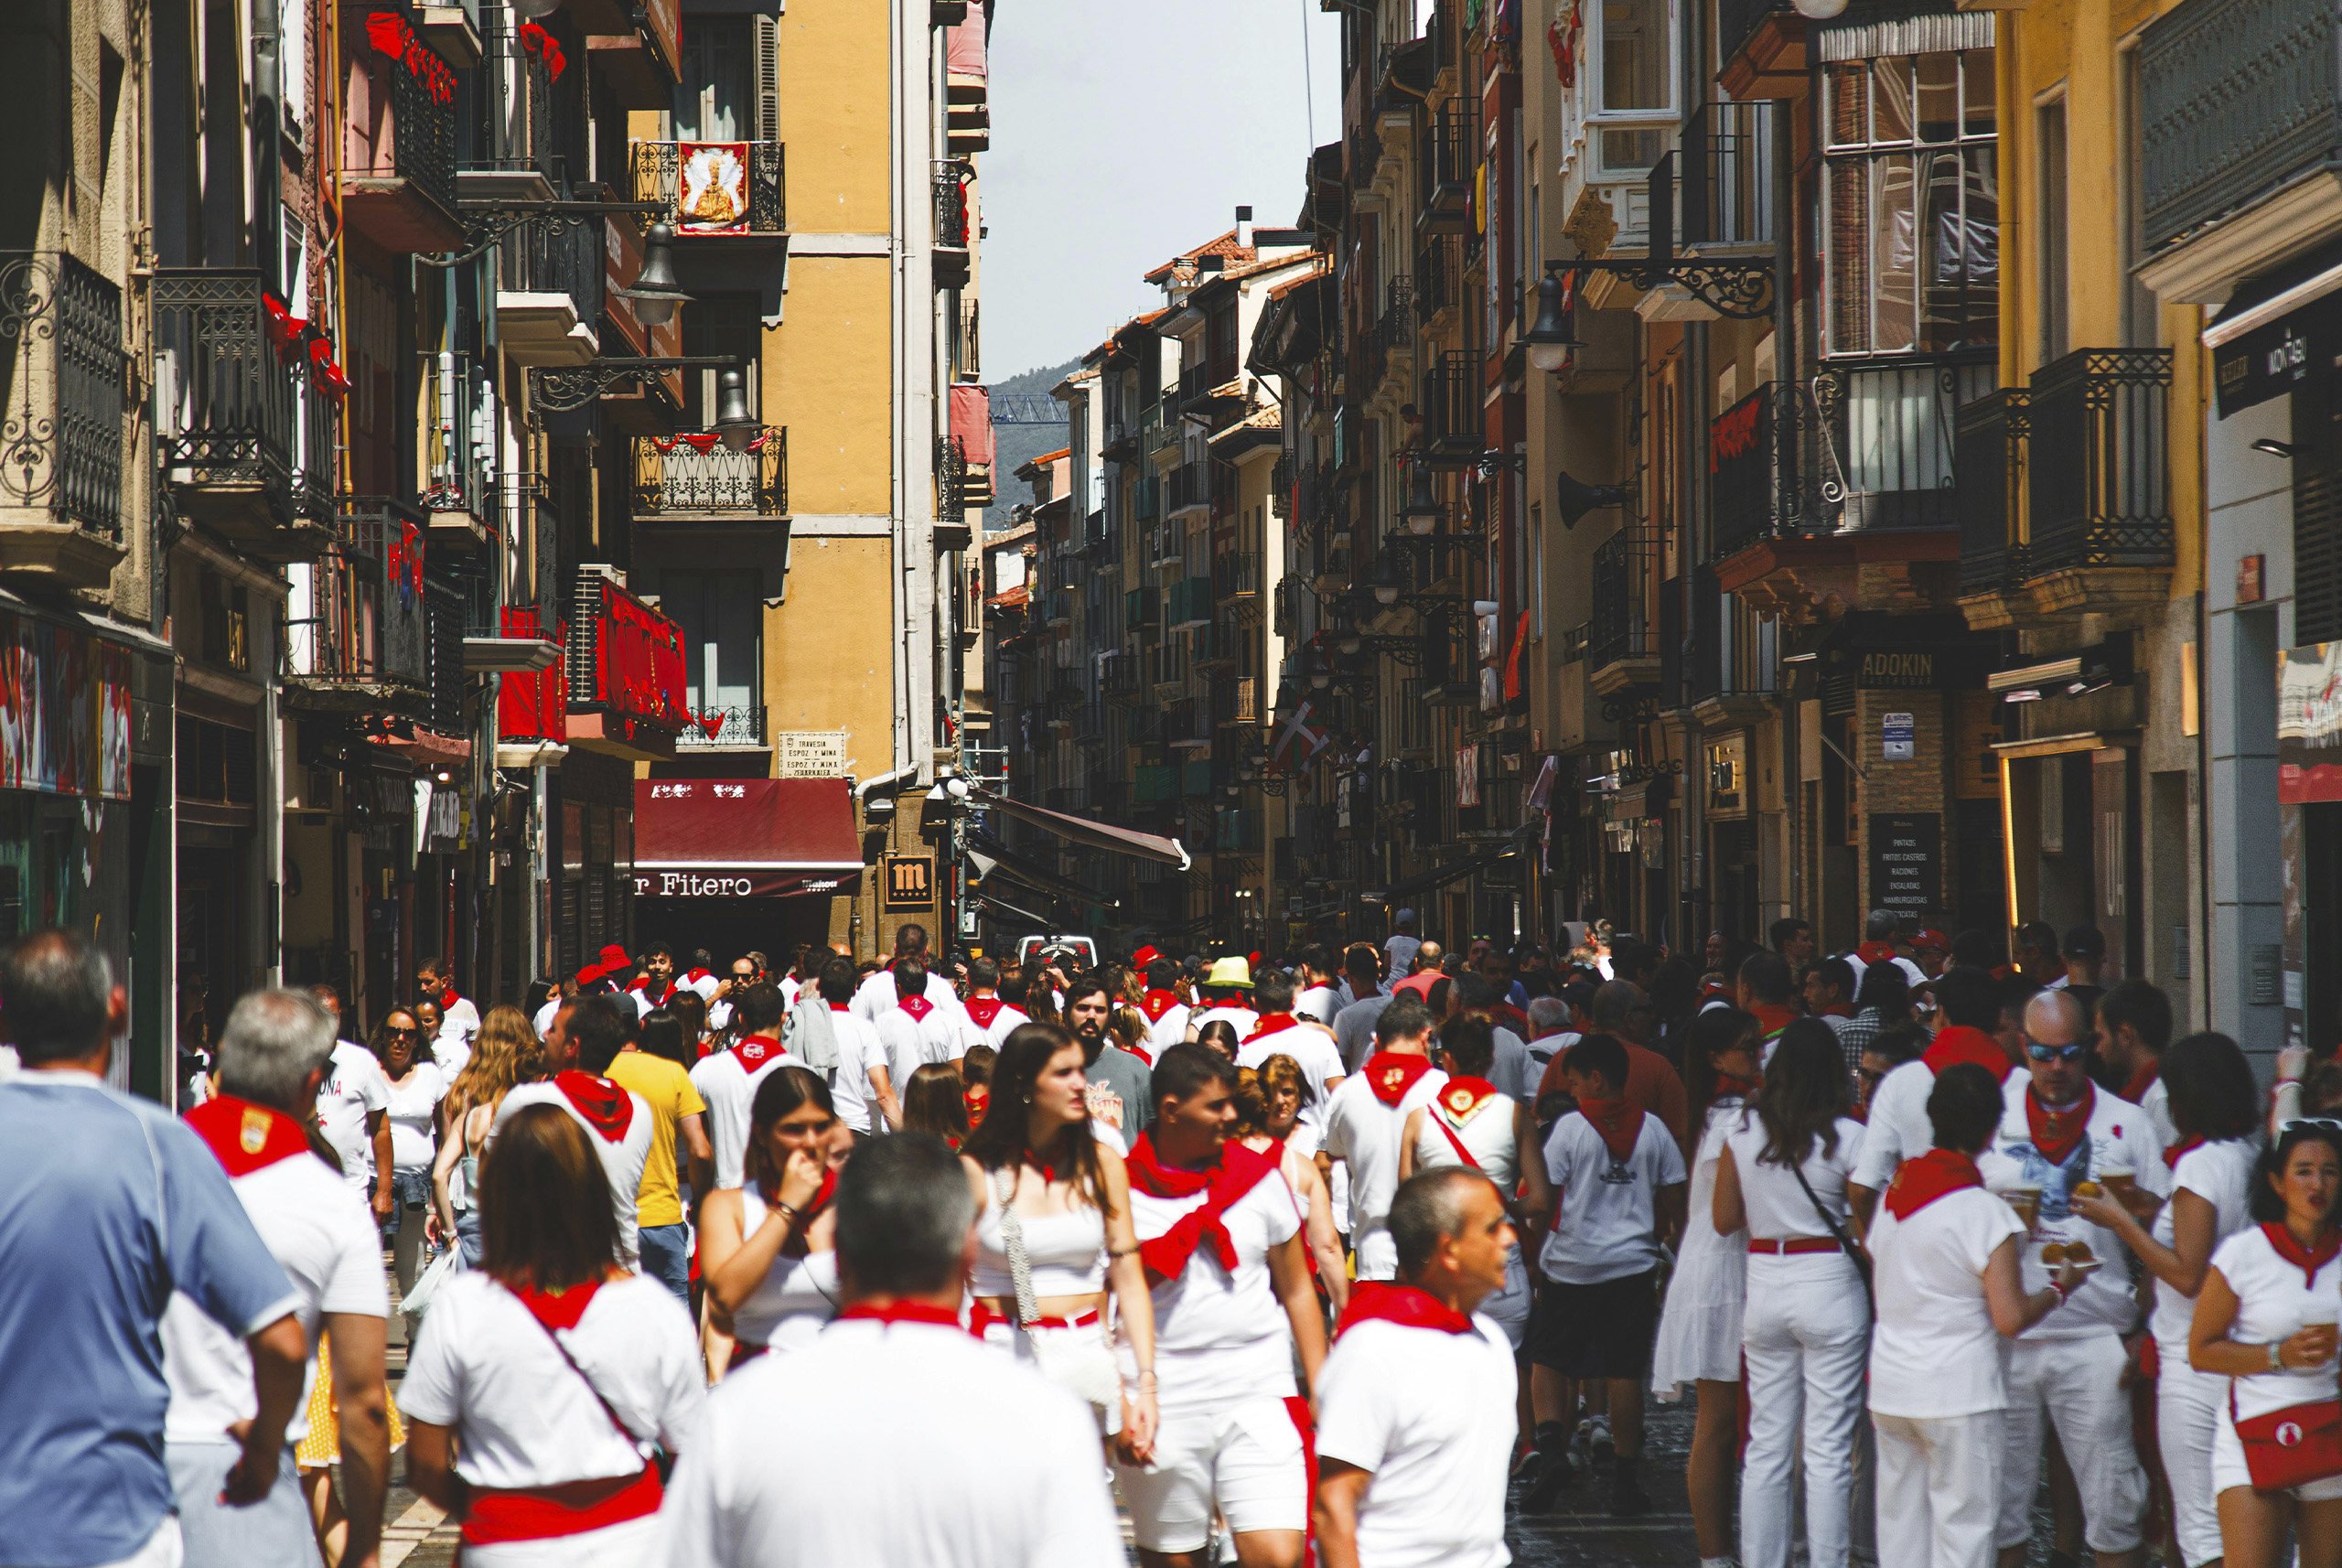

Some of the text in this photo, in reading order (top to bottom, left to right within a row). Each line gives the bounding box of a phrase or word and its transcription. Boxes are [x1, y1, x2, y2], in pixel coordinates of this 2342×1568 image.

[1863, 653, 1932, 676] ADOKIN
[1892, 867, 1919, 875] RACIONES
[659, 873, 752, 897] Fitero
[1890, 882, 1920, 890] ENSALADAS
